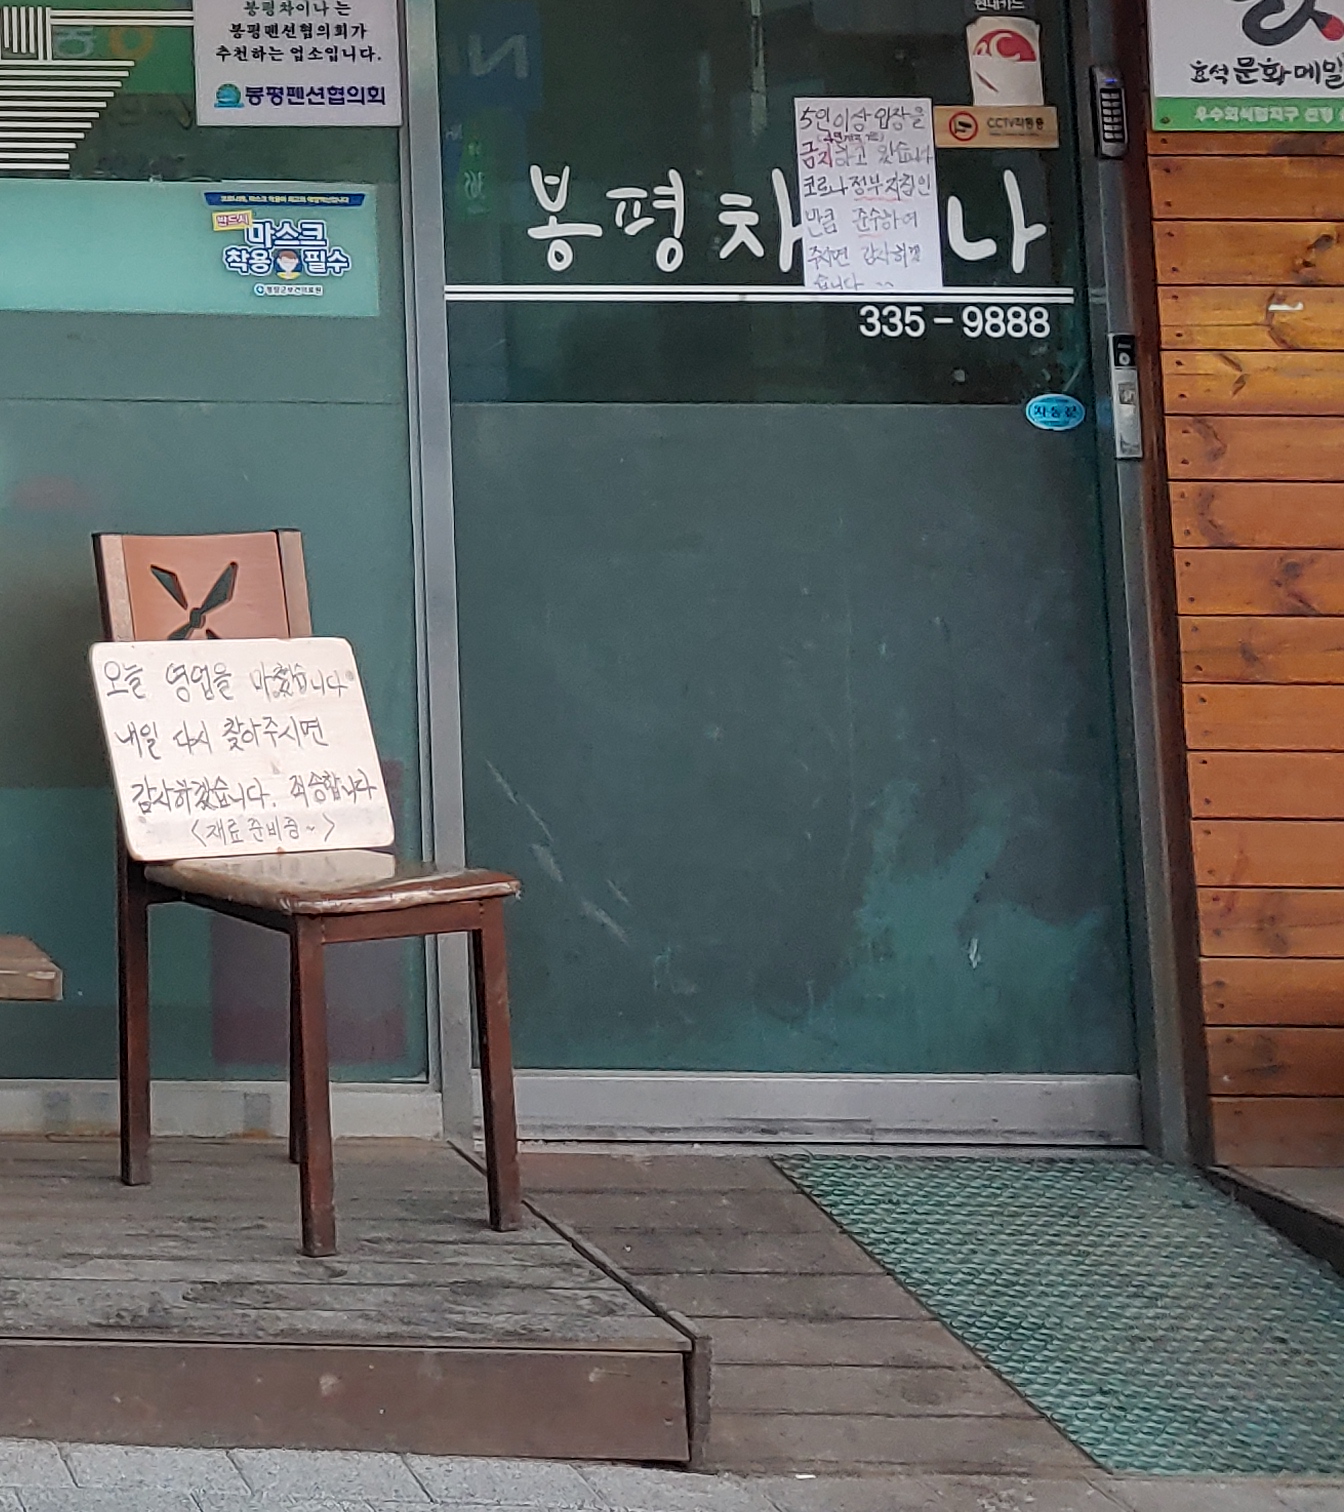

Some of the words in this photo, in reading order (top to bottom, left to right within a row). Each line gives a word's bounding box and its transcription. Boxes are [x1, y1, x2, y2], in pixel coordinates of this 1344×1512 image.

[215, 46, 284, 63] 추천하는
[833, 106, 871, 133] 이상
[799, 140, 868, 169] 금지하고
[216, 214, 250, 226] 반드시
[527, 165, 1047, 273] 봉평차나
[248, 220, 327, 248] 마스크
[225, 248, 272, 274] 착용
[303, 249, 349, 274] 필수
[103, 660, 146, 699] 오늘
[165, 662, 234, 702] 영업을
[114, 721, 161, 760] 내일
[172, 720, 212, 754] 다시
[221, 715, 328, 751] 찾아주시면
